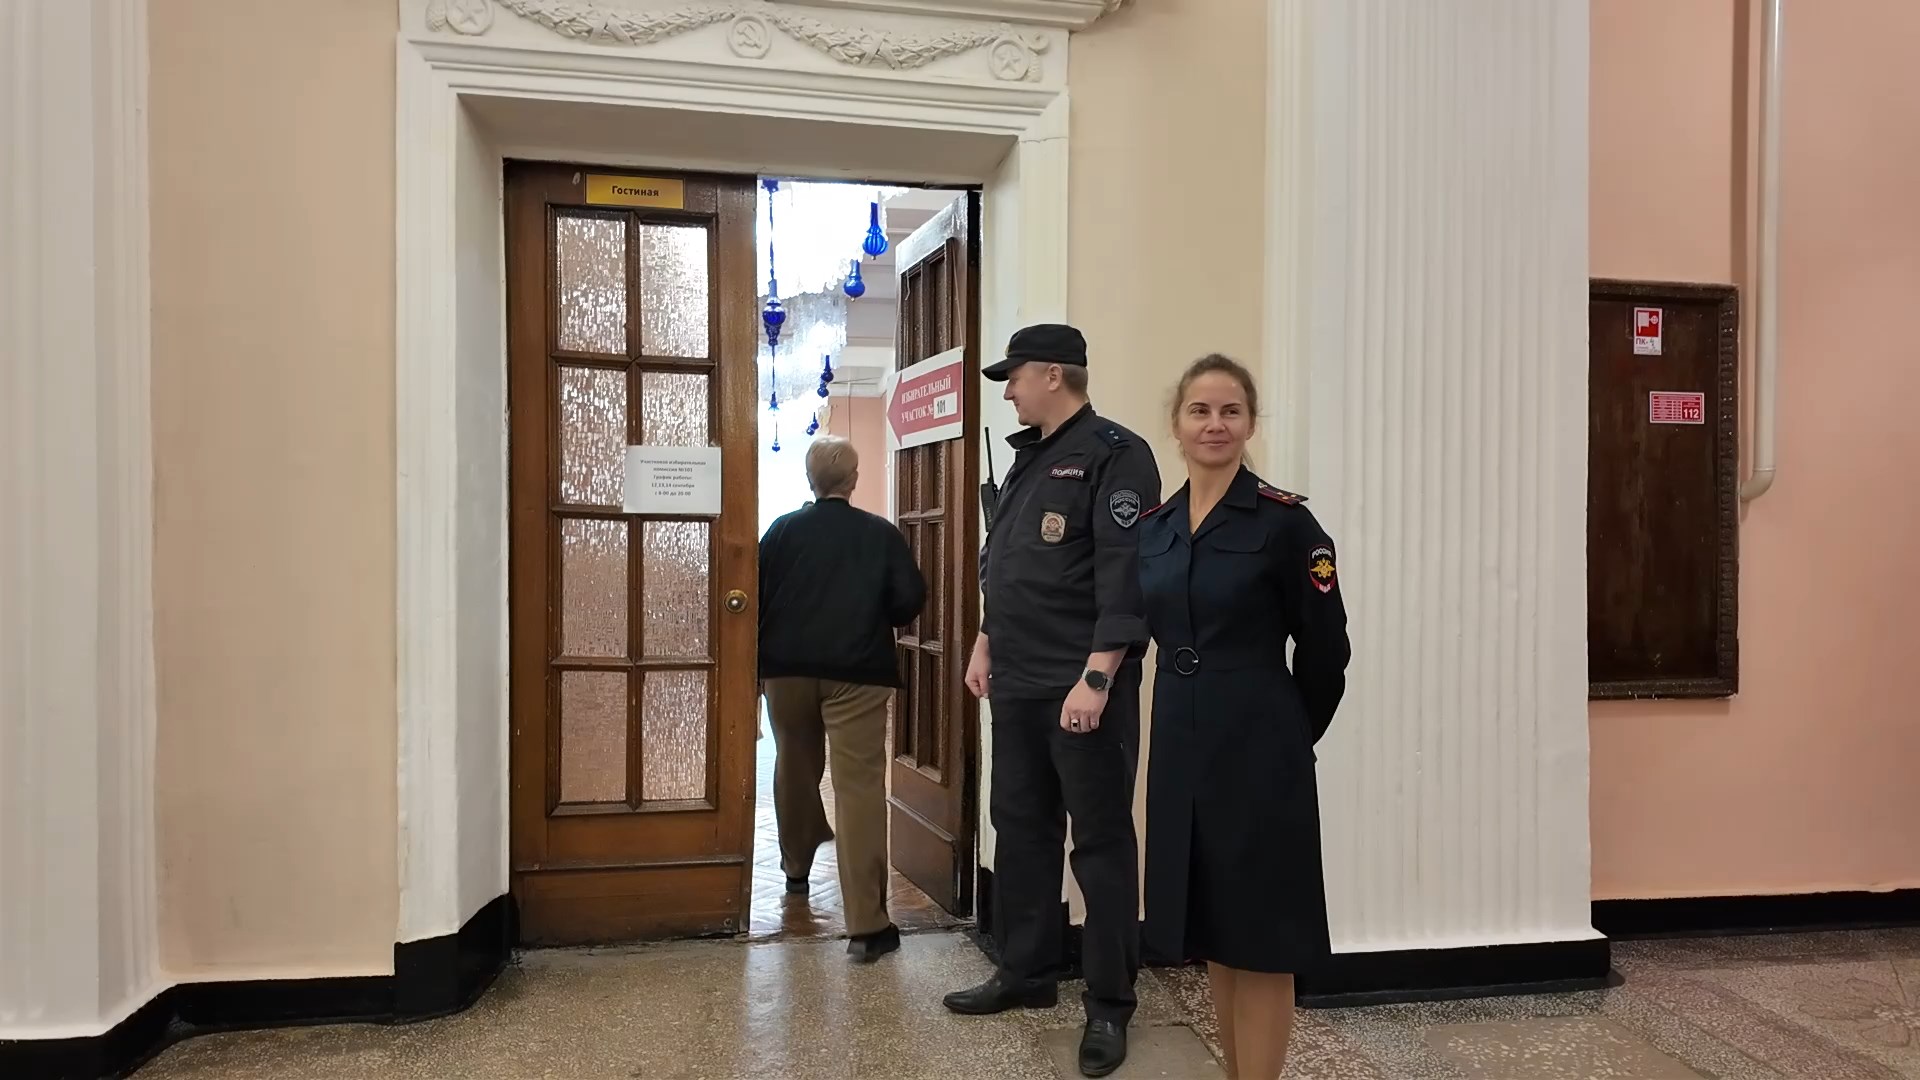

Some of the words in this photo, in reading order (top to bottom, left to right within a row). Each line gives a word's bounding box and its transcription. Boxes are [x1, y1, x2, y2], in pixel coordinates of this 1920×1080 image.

[612, 185, 659, 197] Гостиная
[901, 374, 951, 404] ИЗБИРАТЕЛЬНЫЙ
[901, 406, 927, 423] УЧАСТОК
[936, 399, 946, 414] 101
[1683, 408, 1699, 419] 112
[1051, 468, 1085, 478] ПОЛИЦИЯ
[1114, 497, 1136, 506] РОССИЯ
[1311, 547, 1332, 559] РОССИЯ
